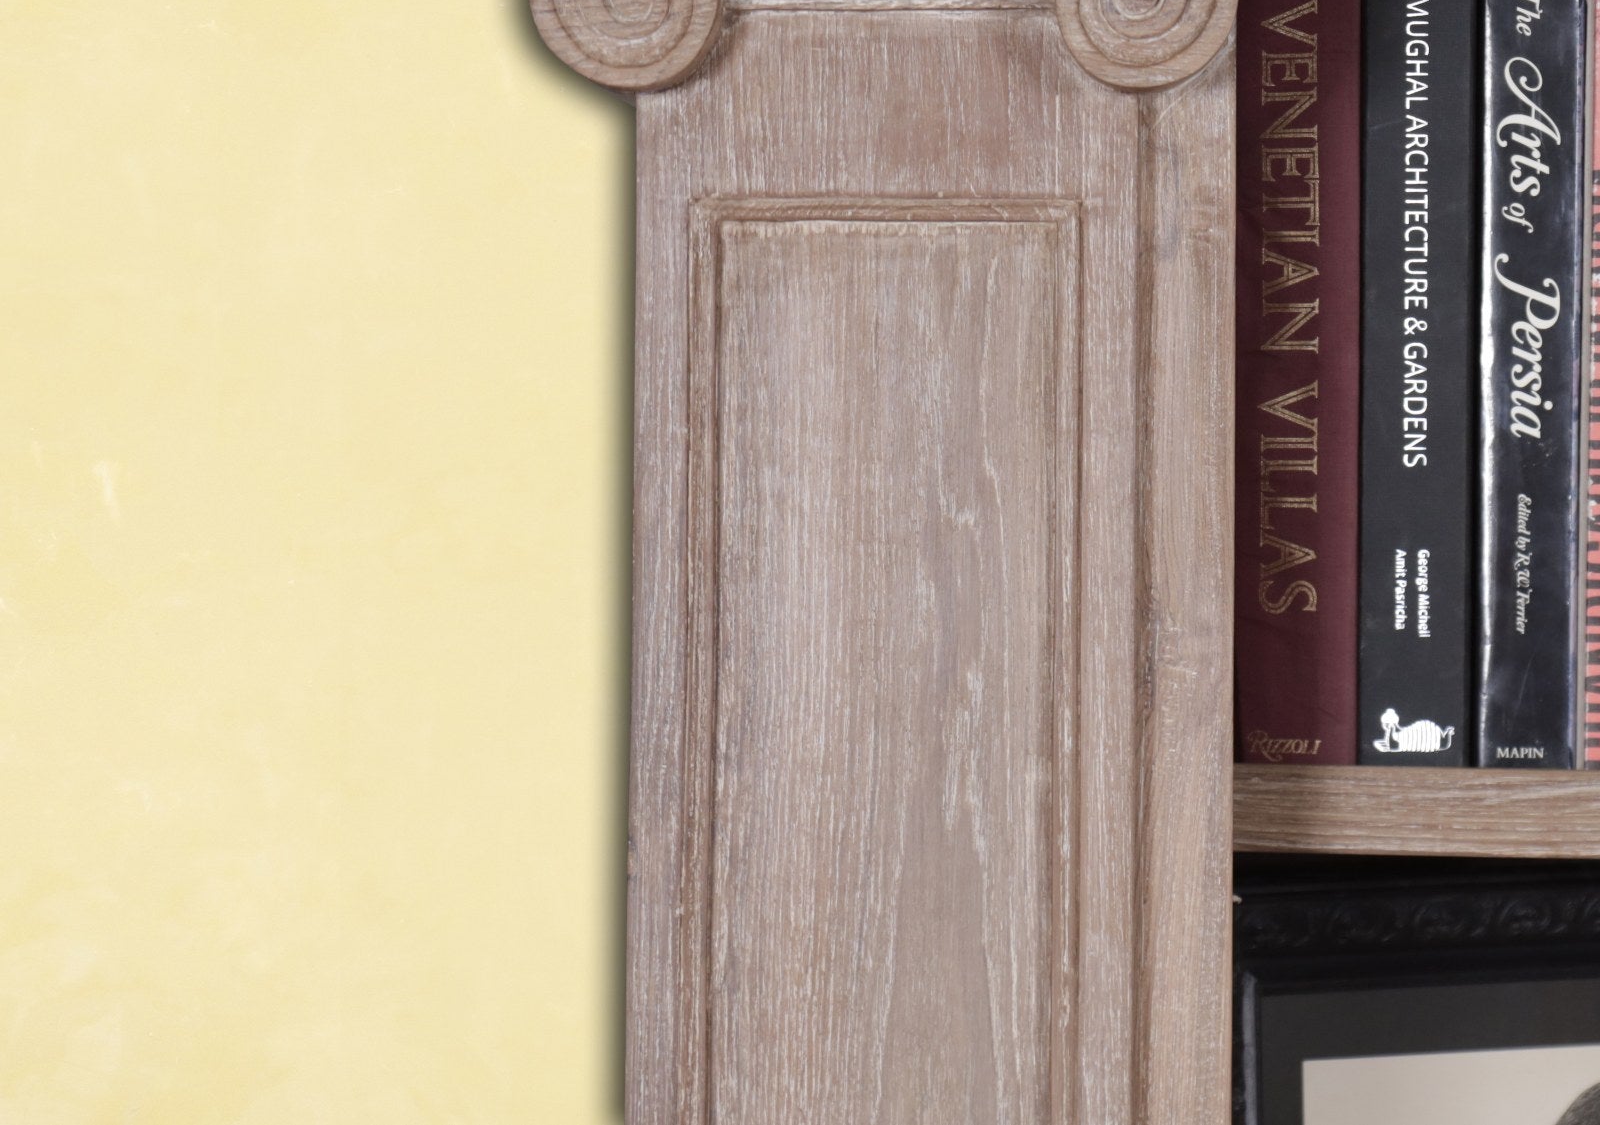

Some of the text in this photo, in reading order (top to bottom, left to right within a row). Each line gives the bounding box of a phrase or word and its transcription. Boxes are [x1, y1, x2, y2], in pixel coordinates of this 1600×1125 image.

[1496, 56, 1562, 198] Arts
[1403, 114, 1430, 311] ARCHITECTURE
[1502, 201, 1535, 235] of
[1402, 316, 1429, 336] &
[1493, 252, 1562, 440] Persia
[1402, 341, 1429, 468] GARDENS
[1257, 379, 1319, 615] VILLAS
[1516, 493, 1533, 536] Edited
[1514, 534, 1532, 552] by
[1394, 548, 1408, 631] Amit Pasricha
[1414, 548, 1431, 638] George Michell
[1515, 588, 1534, 635] Ferrier
[1495, 746, 1545, 760] MAPIN
